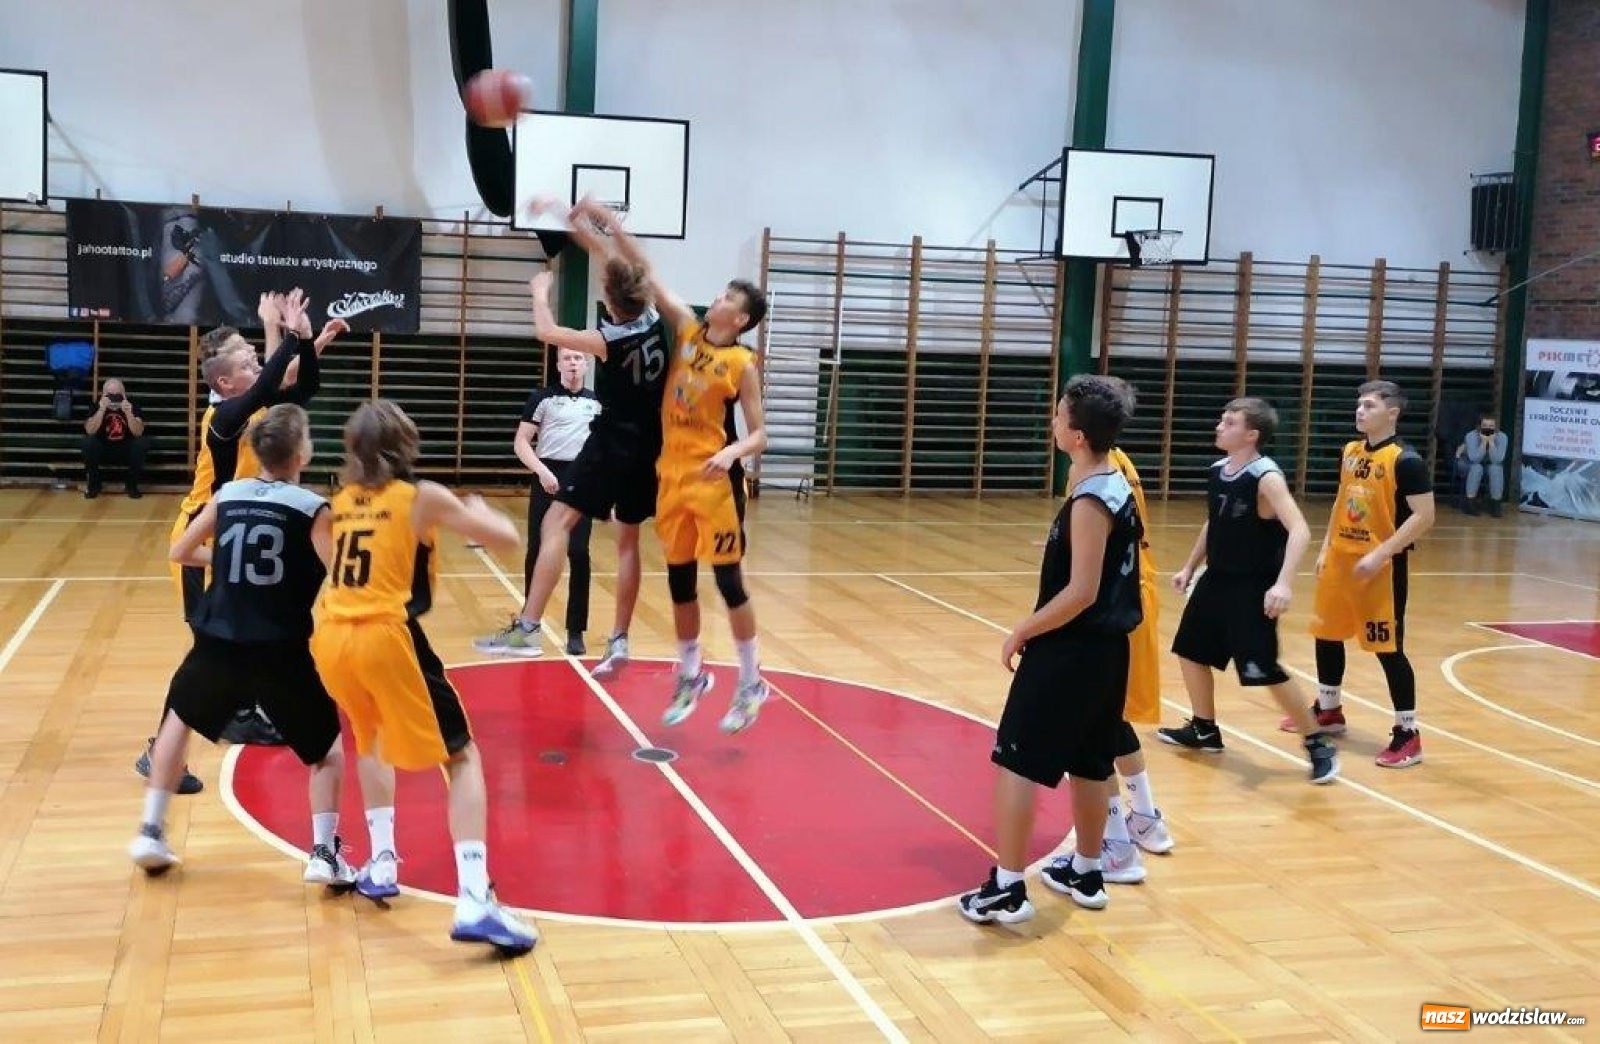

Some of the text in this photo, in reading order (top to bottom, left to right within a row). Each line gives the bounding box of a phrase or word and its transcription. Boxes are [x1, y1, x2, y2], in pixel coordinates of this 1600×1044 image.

[219, 253, 255, 265] studio
[301, 257, 378, 273] artystycznego
[621, 334, 665, 386] 15
[218, 522, 285, 586] 13
[332, 529, 375, 589] 15
[713, 532, 736, 554] 22
[1365, 621, 1390, 643] 35
